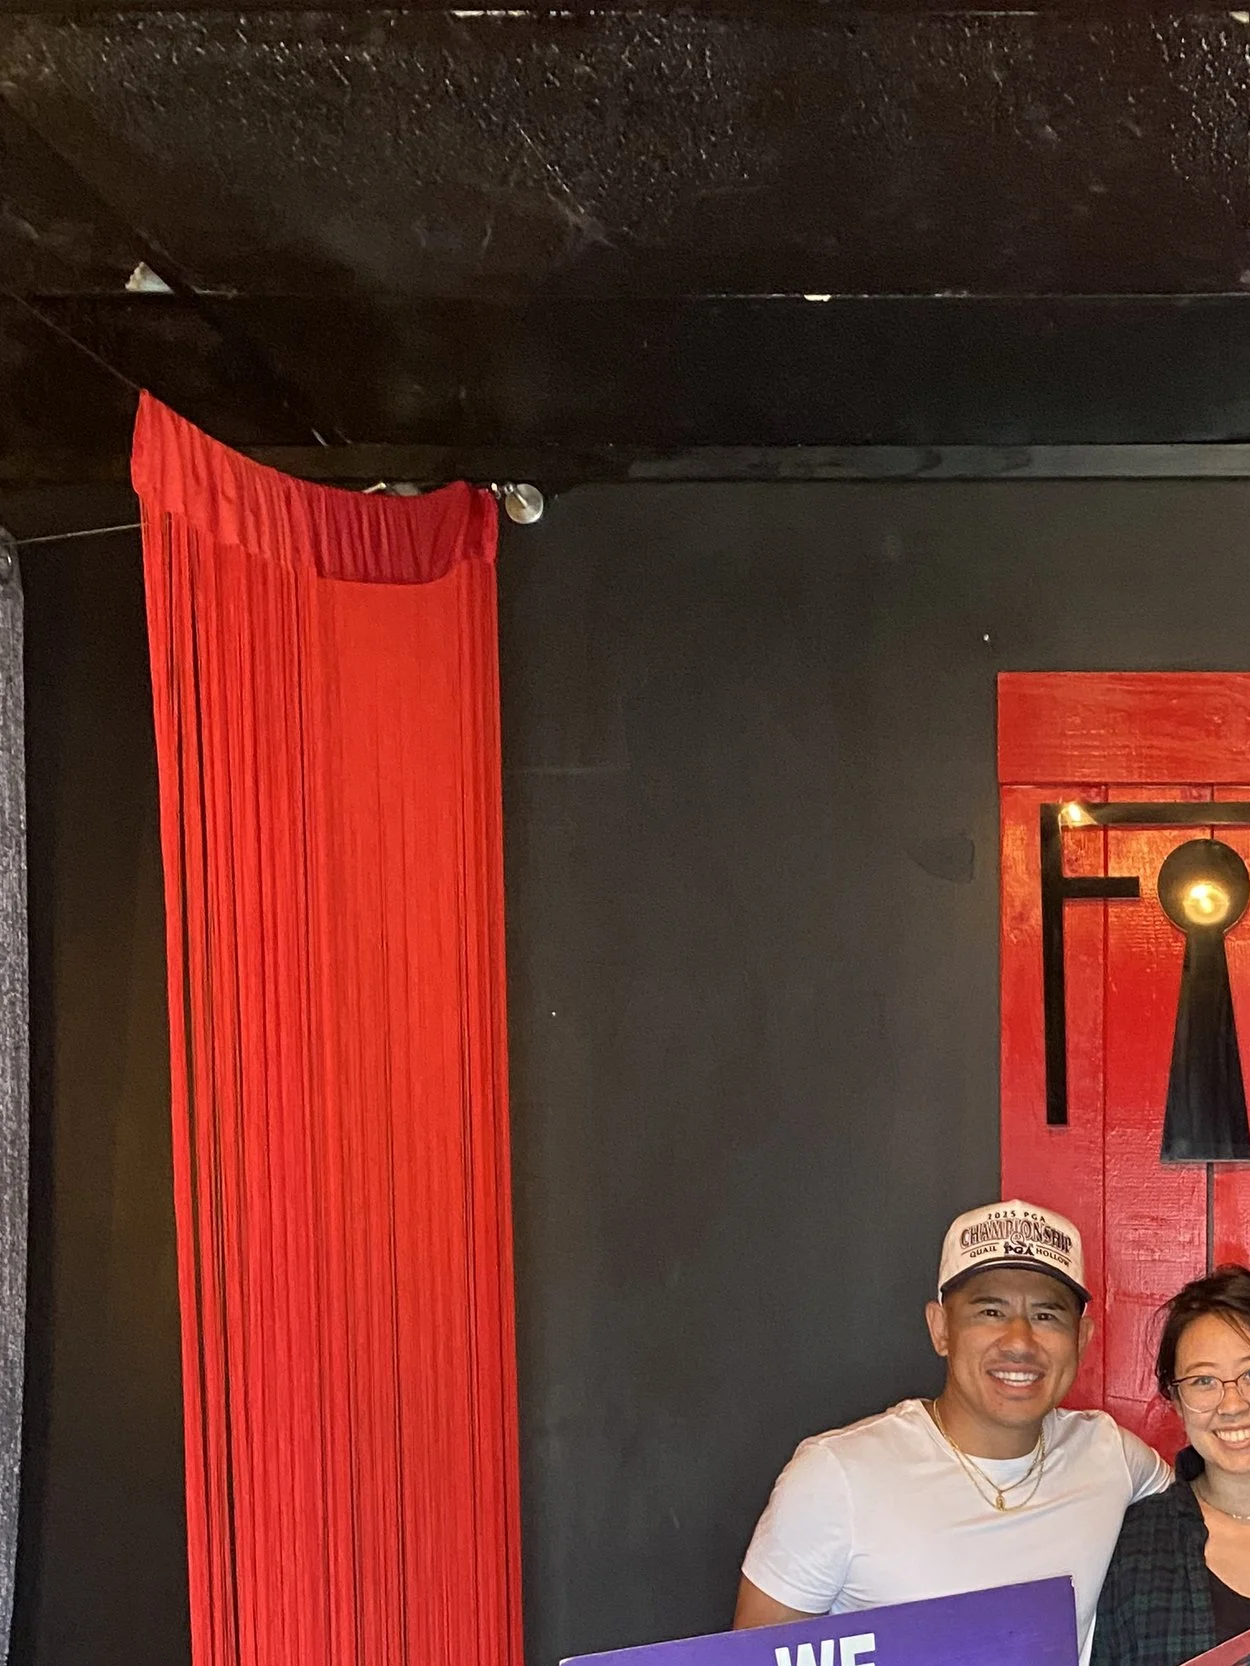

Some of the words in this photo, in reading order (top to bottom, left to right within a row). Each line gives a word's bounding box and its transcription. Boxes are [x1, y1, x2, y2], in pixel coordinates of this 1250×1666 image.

[988, 1210, 1016, 1220] 2025
[1024, 1211, 1046, 1223] PGA
[960, 1218, 1073, 1254] CHAMPIONSHIP
[969, 1245, 998, 1258] QUAIL
[1003, 1245, 1035, 1256] PGA
[1036, 1246, 1070, 1267] HOLLOW
